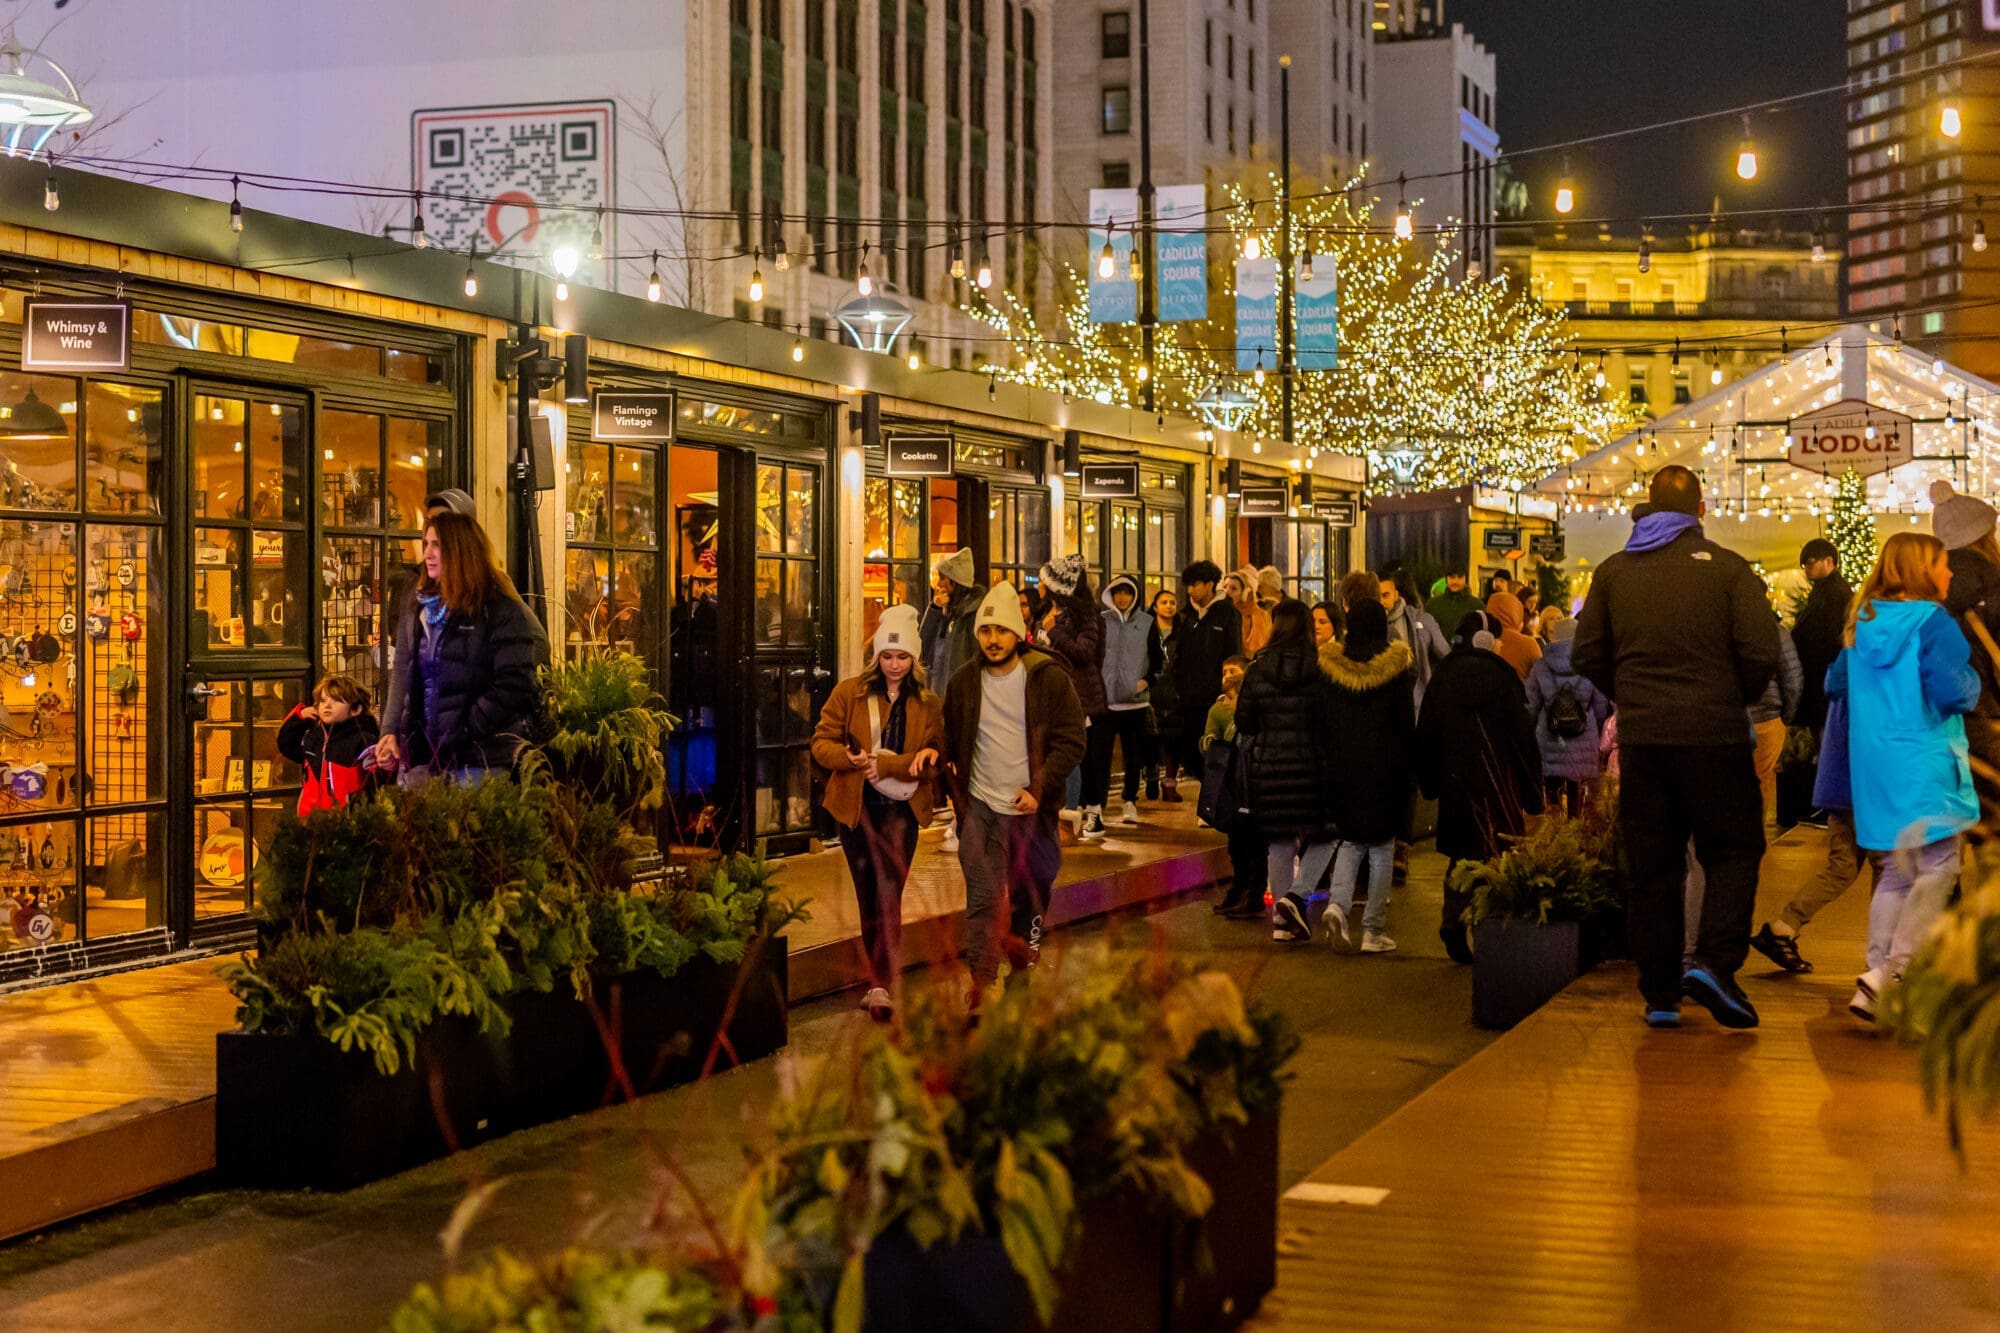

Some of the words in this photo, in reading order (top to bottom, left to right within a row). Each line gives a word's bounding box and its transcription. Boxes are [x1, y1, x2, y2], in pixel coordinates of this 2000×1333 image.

[1159, 245, 1204, 261] CADILLAC
[1163, 266, 1201, 281] SQUARE
[1237, 307, 1276, 320] CADILLAC
[1297, 303, 1336, 319] CADILLAC
[46, 320, 96, 337] Whimsy
[97, 321, 108, 334] &
[1242, 324, 1272, 337] SQUARE
[1301, 322, 1334, 336] SQUARE
[60, 336, 93, 349] Wine
[612, 405, 658, 417] Flamingo
[615, 416, 653, 428] Vintage
[1800, 434, 1901, 454] LODGE
[901, 451, 938, 461] Cookette
[63, 617, 73, 630] E
